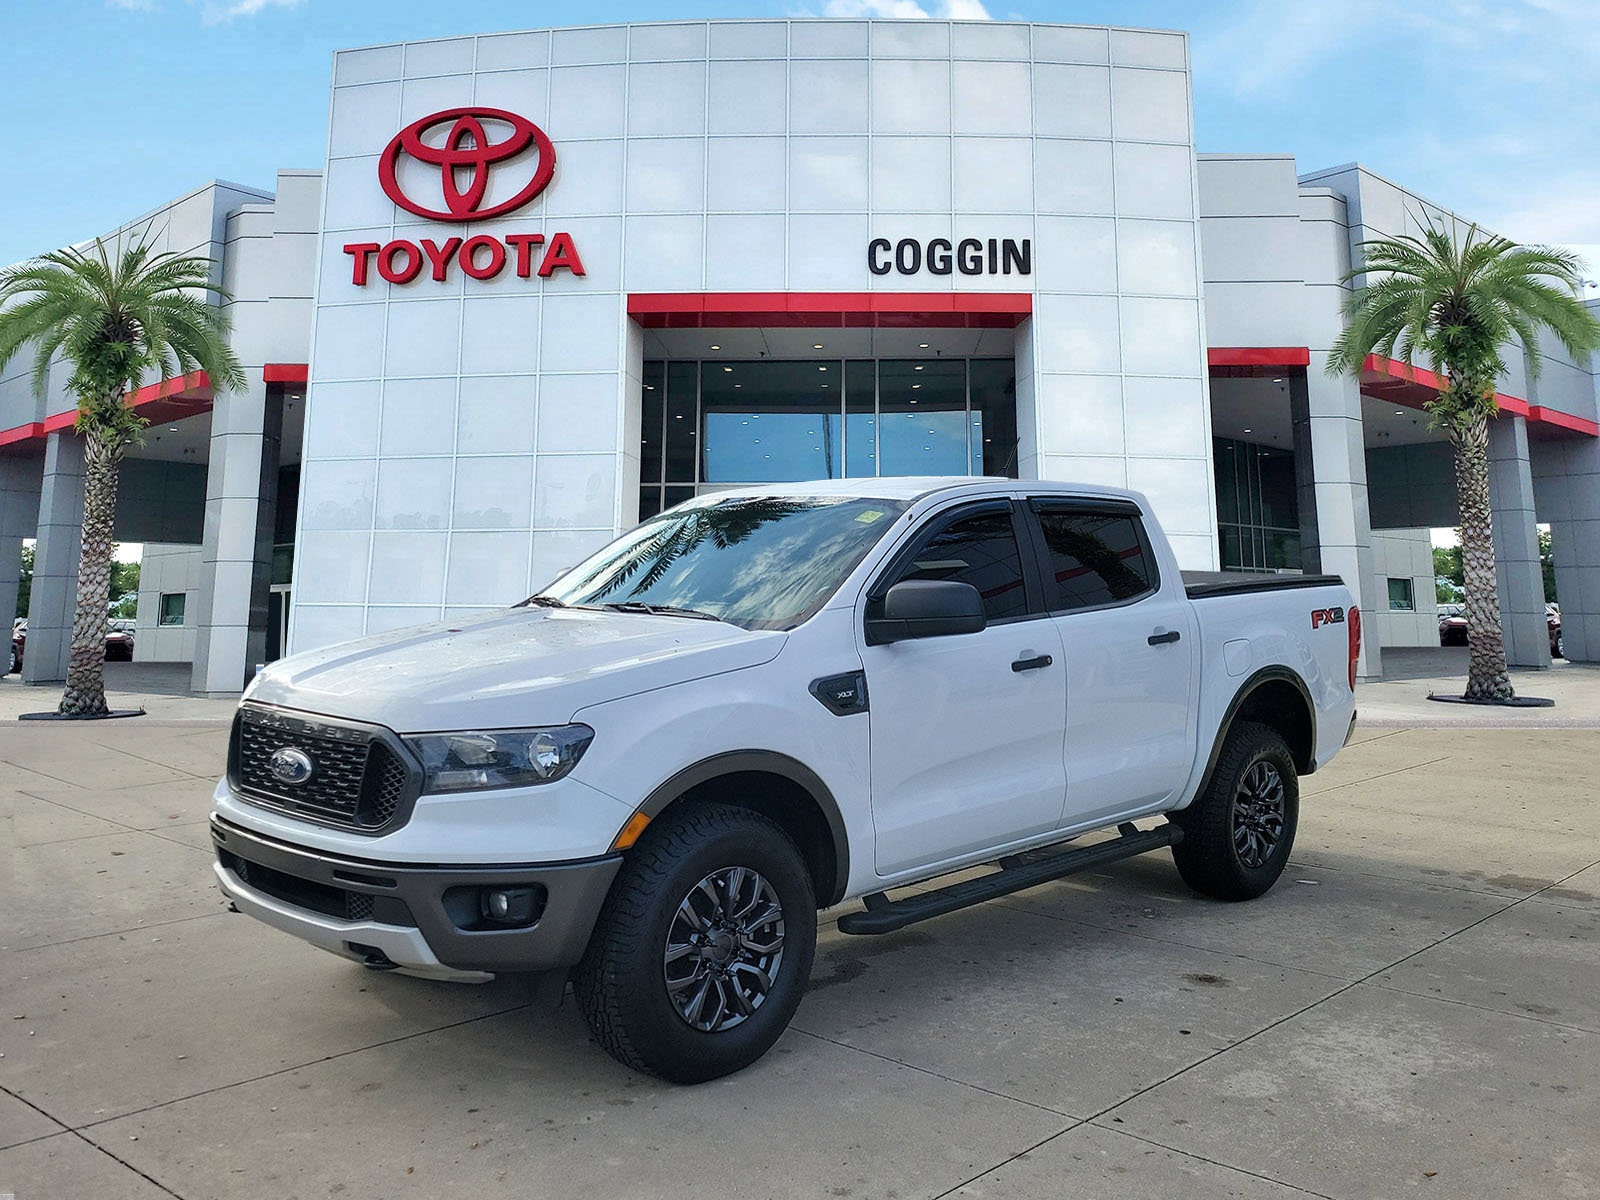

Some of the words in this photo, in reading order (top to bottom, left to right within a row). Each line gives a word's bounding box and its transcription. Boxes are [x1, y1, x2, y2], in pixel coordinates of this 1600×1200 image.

[343, 232, 586, 286] TOYOTA
[868, 238, 1032, 275] COGGIN
[1311, 606, 1345, 629] FX2
[837, 690, 854, 699] XLT
